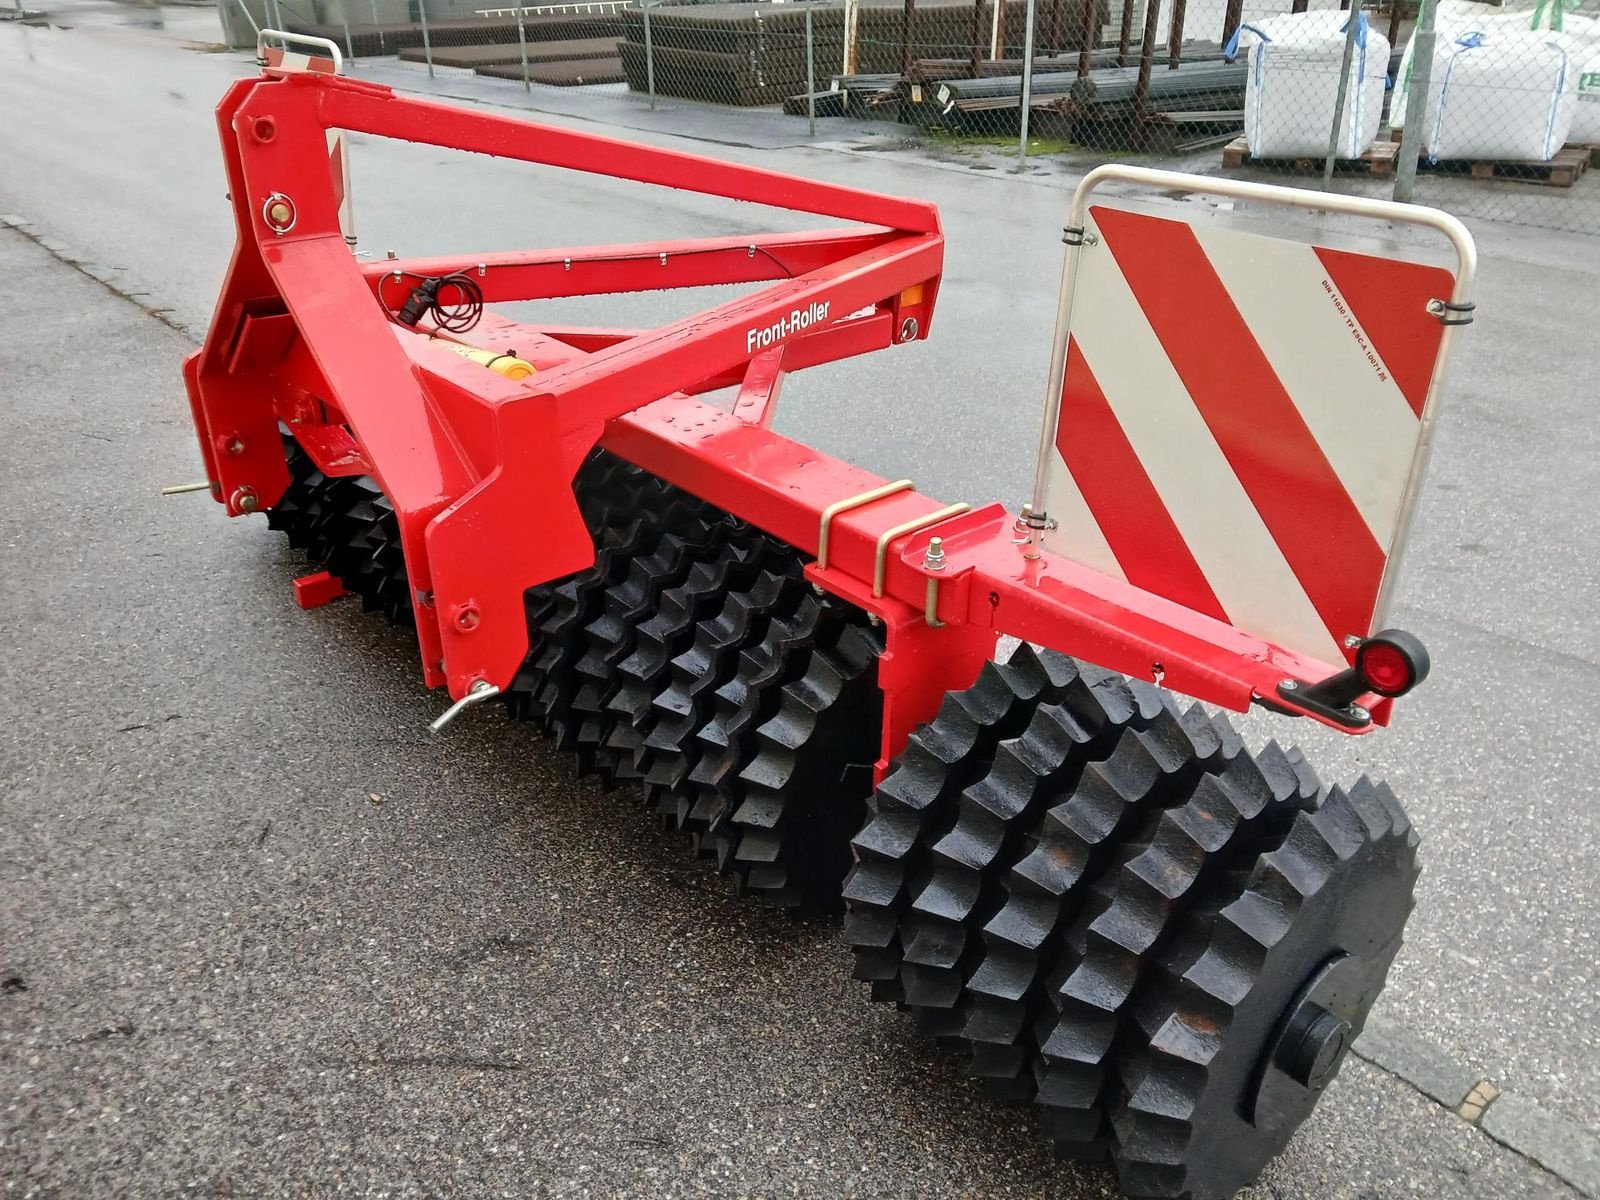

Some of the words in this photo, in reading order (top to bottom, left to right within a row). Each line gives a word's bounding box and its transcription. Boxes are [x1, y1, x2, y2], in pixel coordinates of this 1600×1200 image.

[747, 301, 830, 353] Front-Roller
[1321, 279, 1332, 293] DIN
[1330, 294, 1346, 315] 11030
[1346, 319, 1354, 328] TP
[1352, 329, 1367, 350] ESC-A
[1366, 351, 1381, 372] 10071
